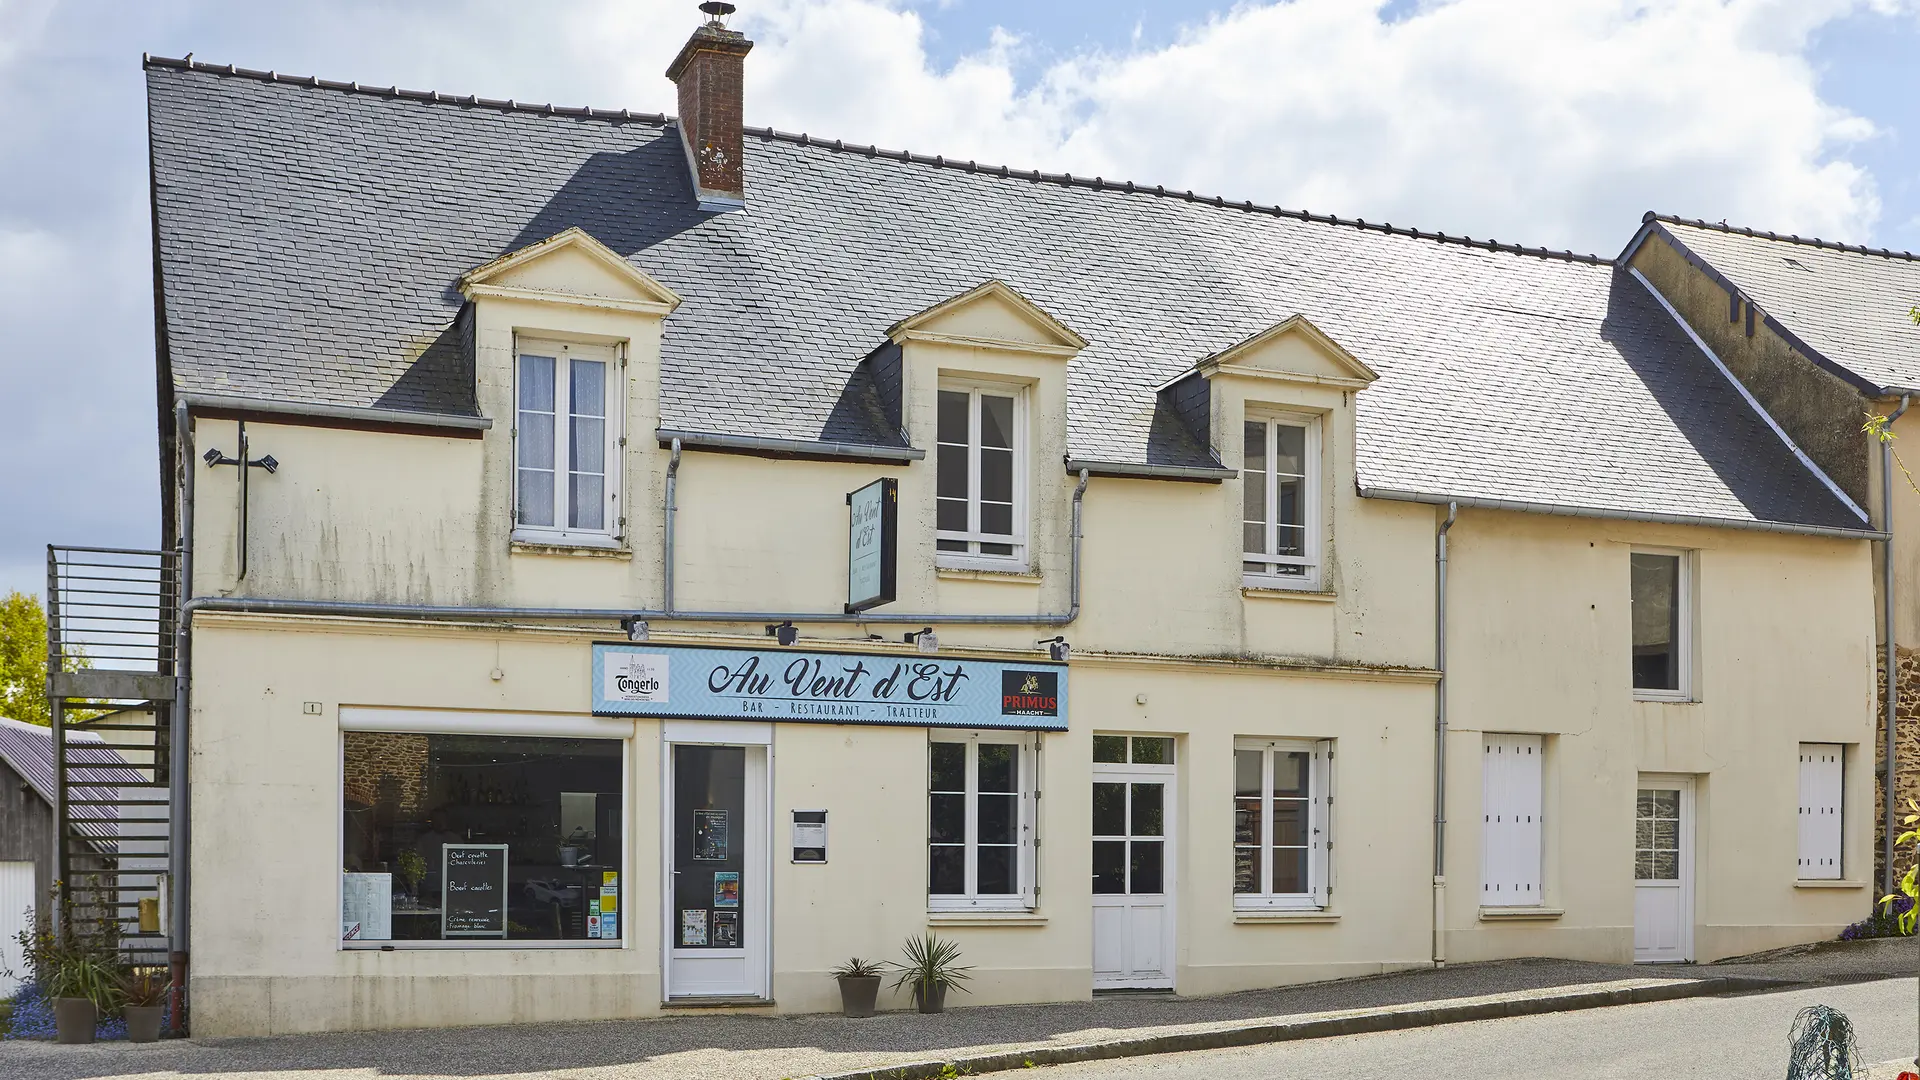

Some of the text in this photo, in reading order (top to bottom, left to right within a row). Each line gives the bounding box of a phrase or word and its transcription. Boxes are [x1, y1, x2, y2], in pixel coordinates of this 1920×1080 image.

[615, 674, 659, 694] Tongerlo
[708, 656, 970, 702] Au Vent d'Est
[742, 701, 938, 718] BAR RESTAURANT TRAITEUR
[1003, 695, 1057, 709] PRIMUS
